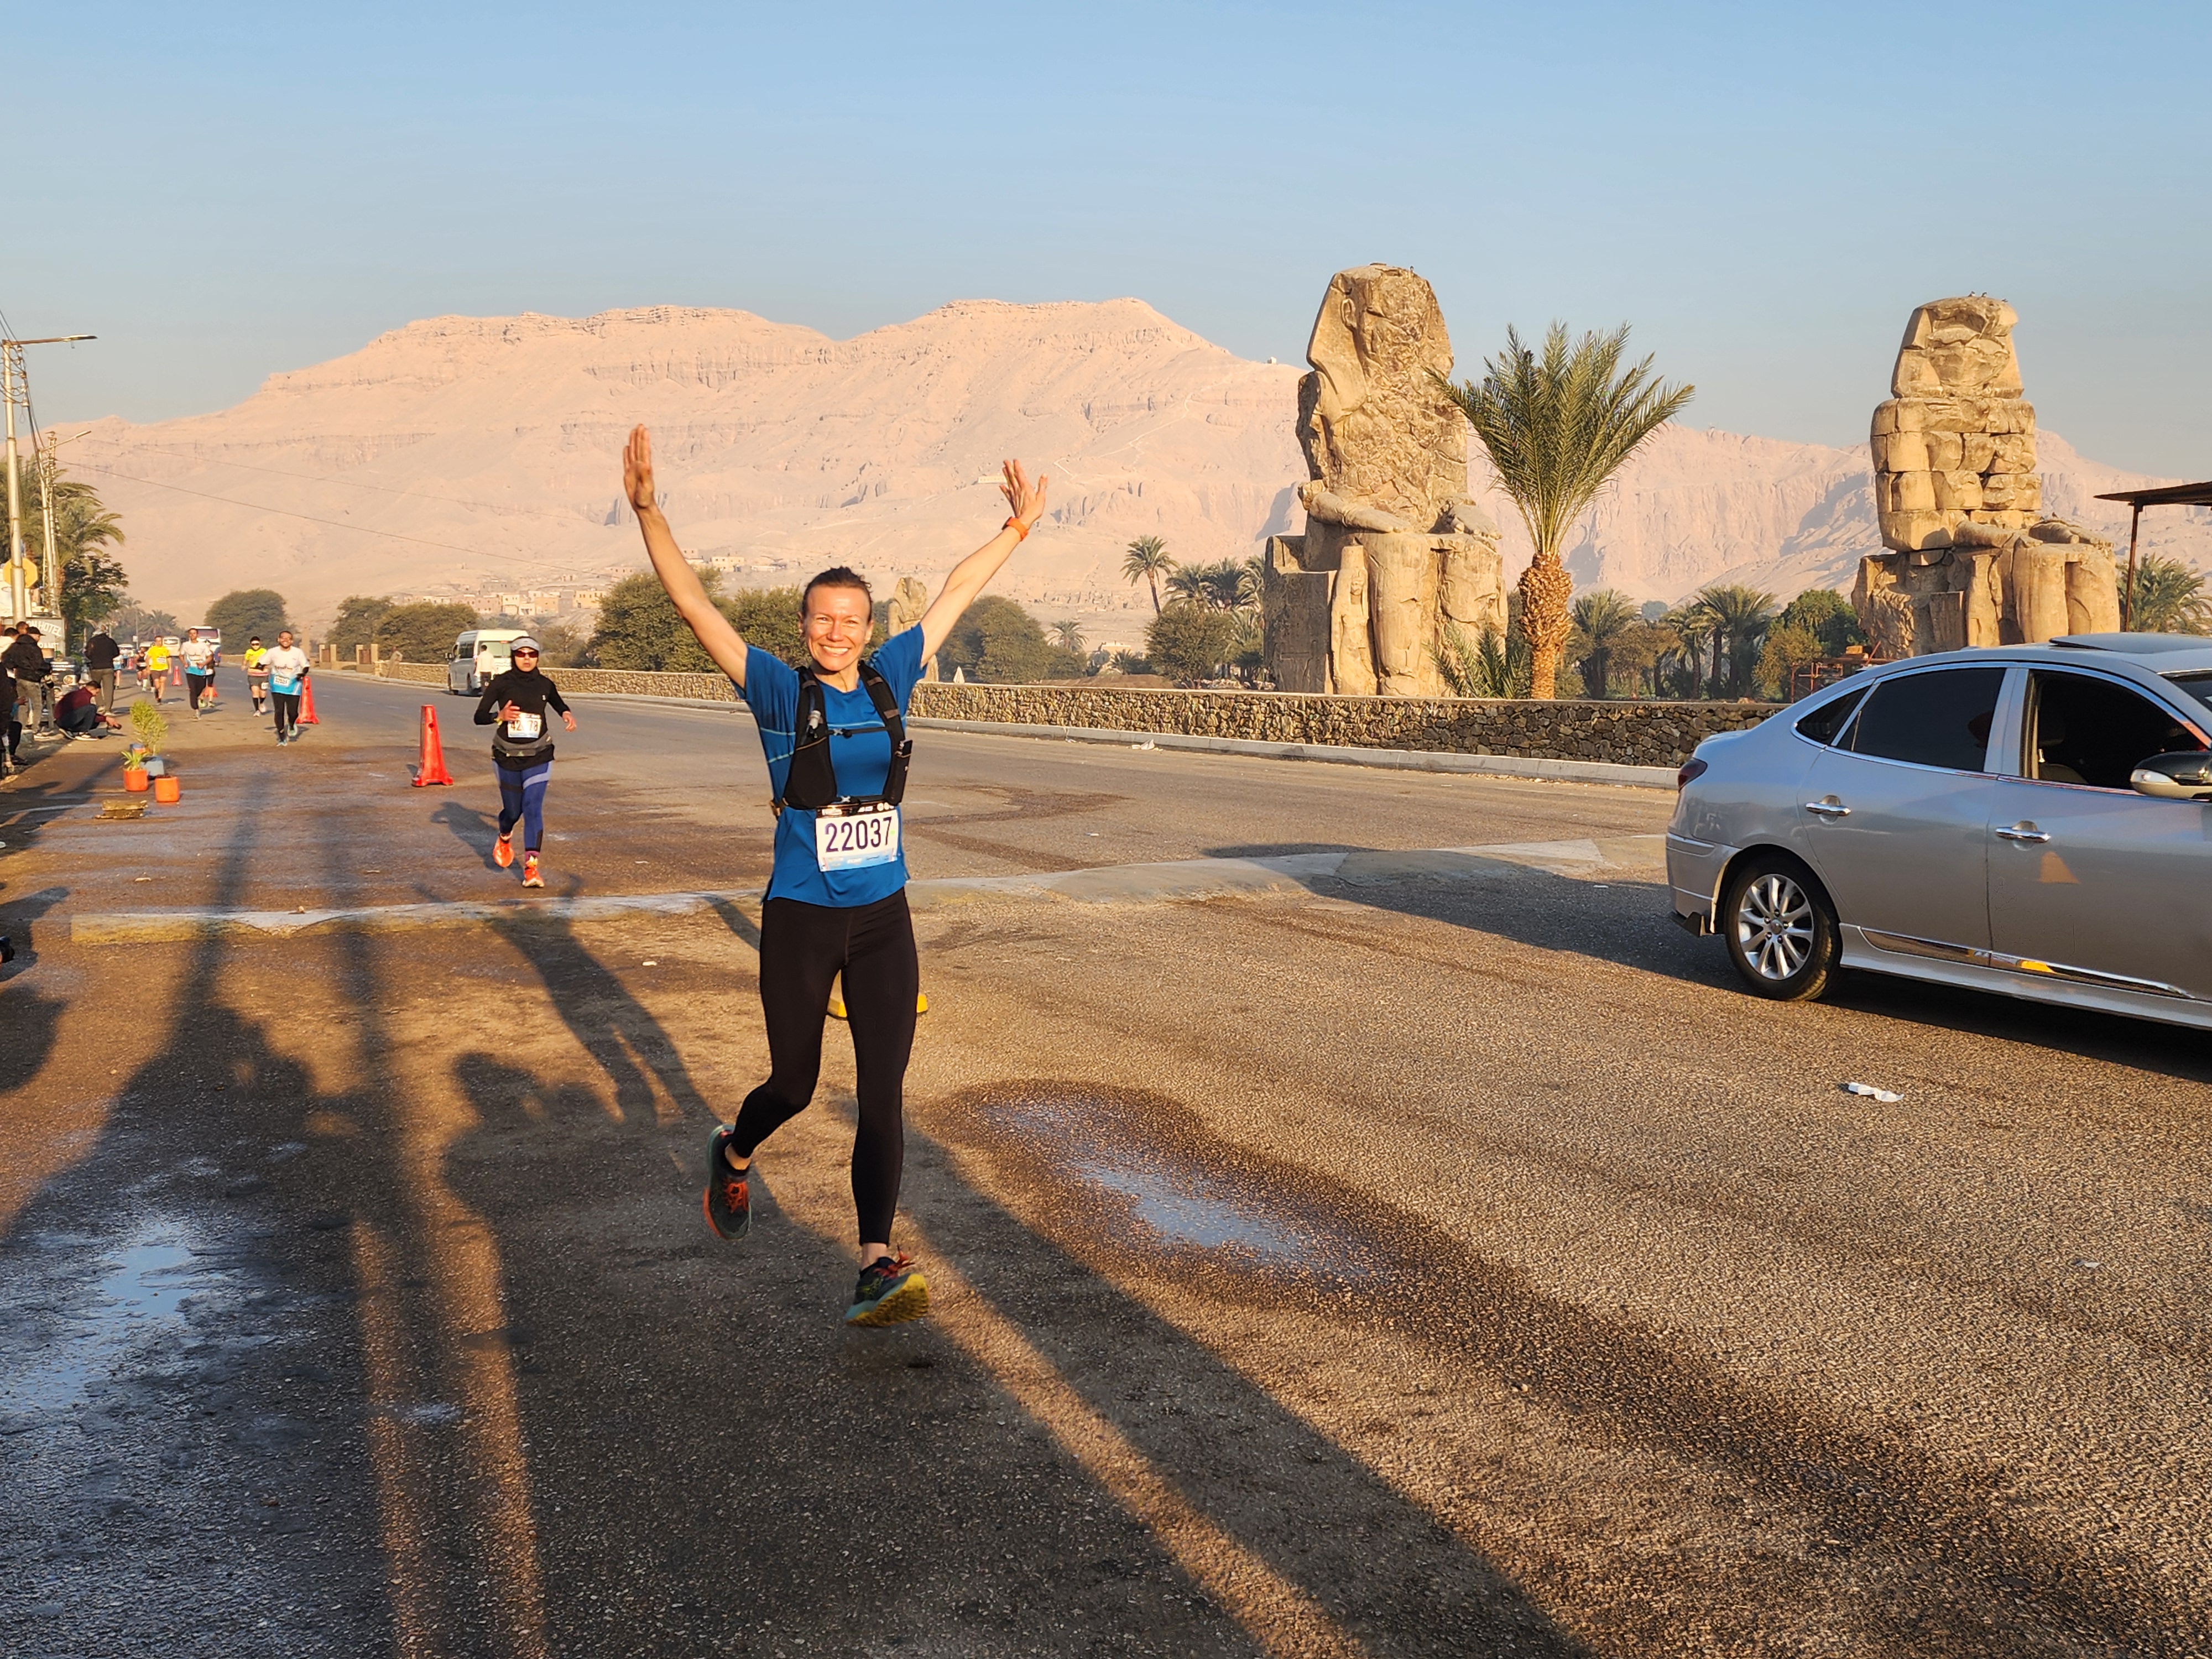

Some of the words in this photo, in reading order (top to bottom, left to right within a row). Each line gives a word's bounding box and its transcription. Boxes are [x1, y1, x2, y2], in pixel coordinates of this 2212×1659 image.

[38, 620, 62, 637] HOTEL
[510, 719, 538, 732] 4278
[825, 816, 893, 853] 22037
